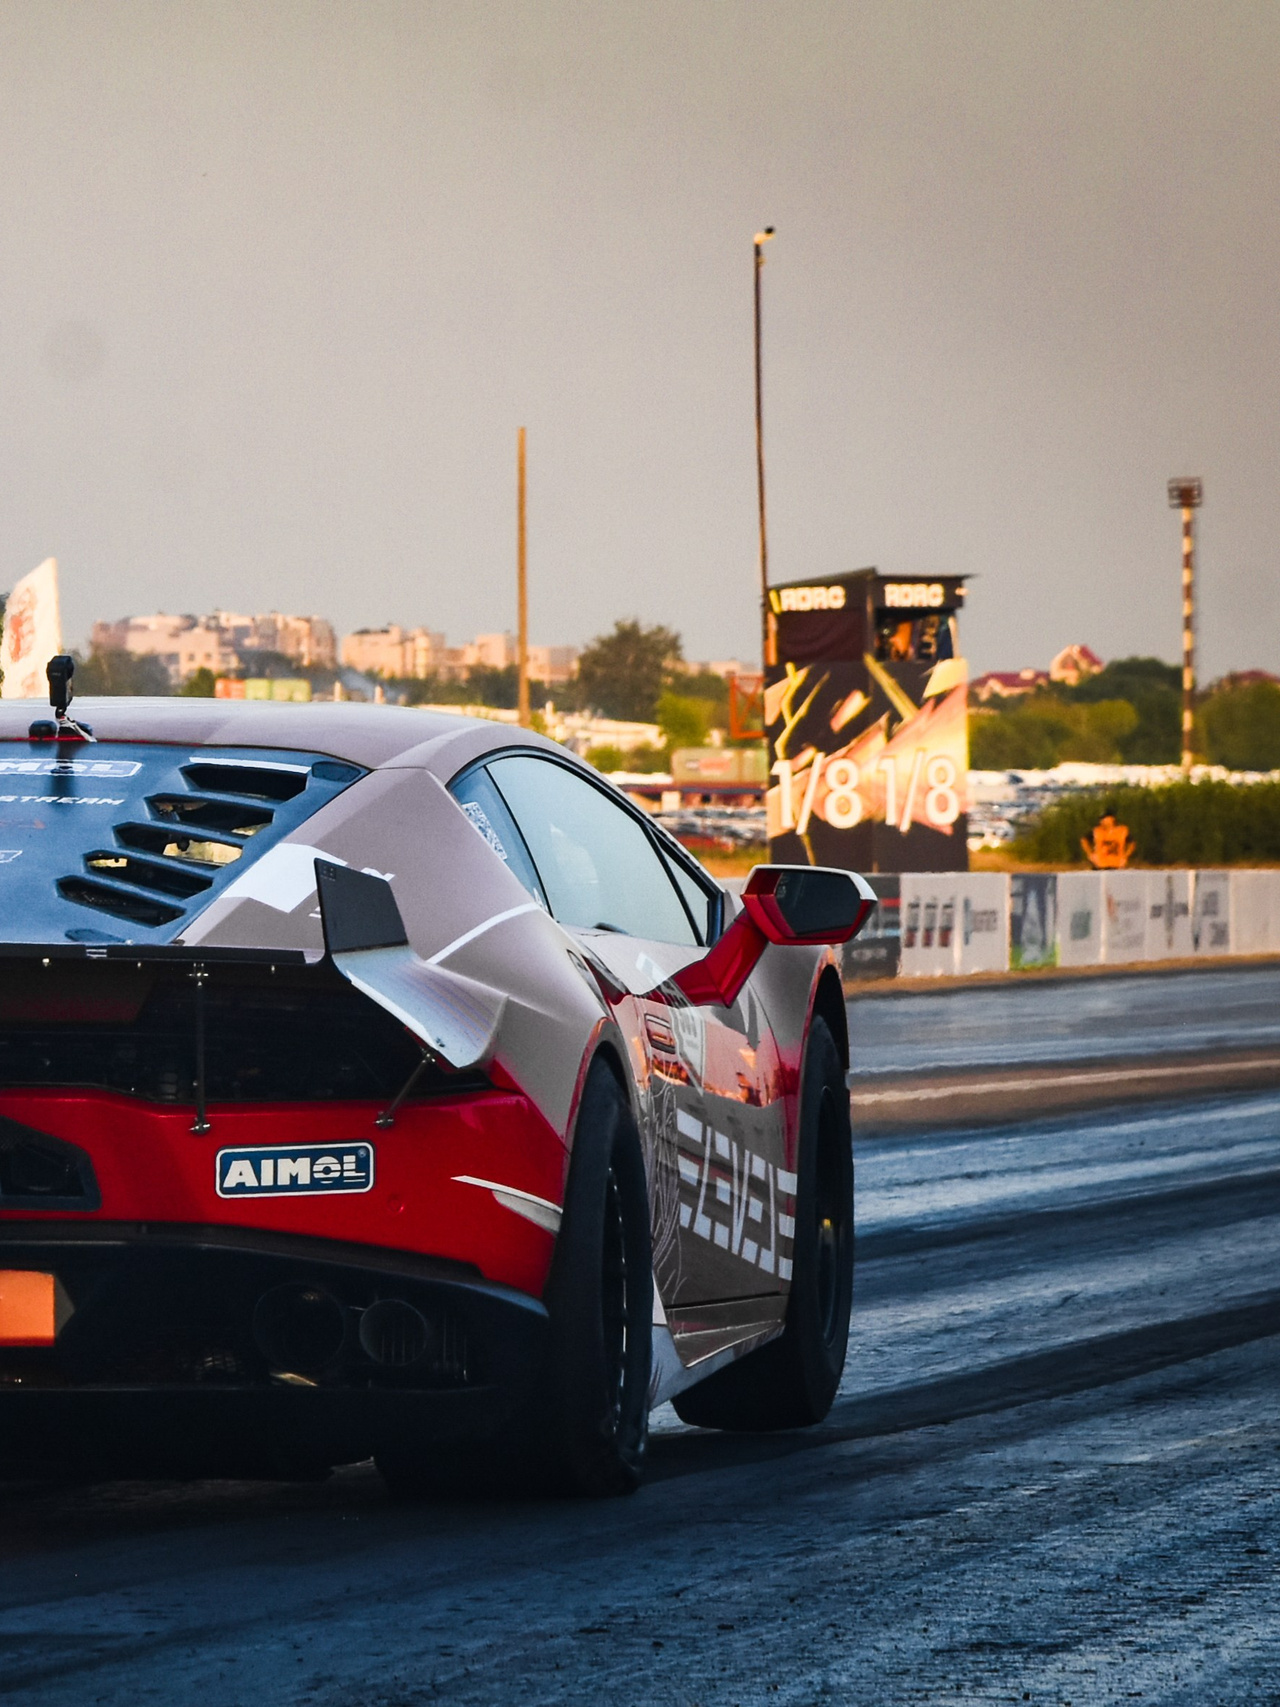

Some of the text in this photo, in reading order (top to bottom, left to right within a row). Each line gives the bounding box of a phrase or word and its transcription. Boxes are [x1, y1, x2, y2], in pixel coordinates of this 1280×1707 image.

[780, 586, 846, 611] RDRC
[770, 752, 862, 835] 1/8
[877, 748, 960, 832] 1/8
[222, 1154, 366, 1188] AIMOL
